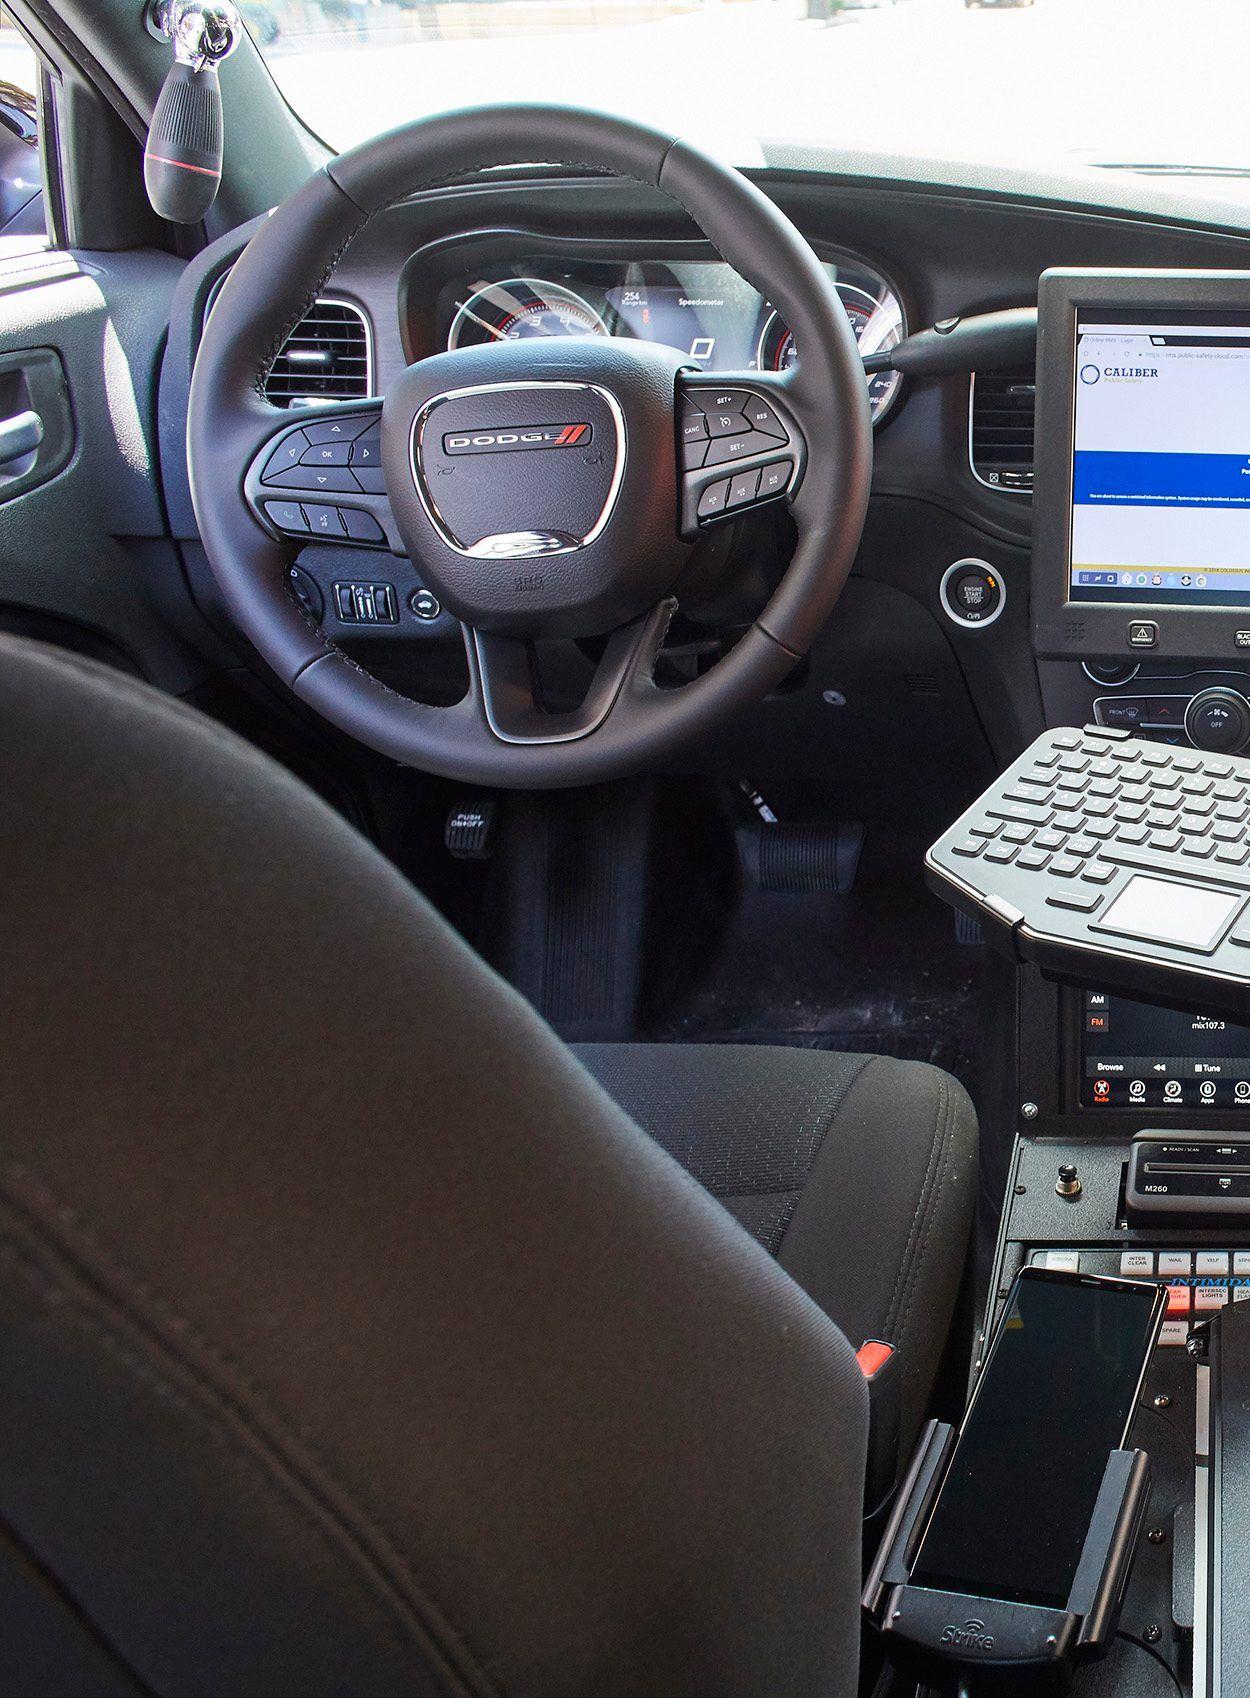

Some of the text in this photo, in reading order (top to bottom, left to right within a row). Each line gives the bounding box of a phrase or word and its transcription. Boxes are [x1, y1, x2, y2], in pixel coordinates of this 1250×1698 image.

[624, 292, 640, 300] 254
[530, 316, 542, 327] 3
[690, 338, 715, 359] 0
[1104, 367, 1158, 378] CALIBER
[756, 412, 768, 420] RES
[684, 426, 700, 434] CANC
[449, 432, 565, 448] DODGE
[322, 450, 333, 458] OK
[1010, 805, 1031, 814] Shift
[1090, 995, 1105, 1004] AM
[1091, 1018, 1104, 1026] FM
[1191, 1021, 1226, 1030] mix107.3
[1097, 1063, 1124, 1071] Browse
[1203, 1064, 1221, 1072] Tune
[1144, 1185, 1168, 1193] M260
[940, 1624, 995, 1650] Strike
